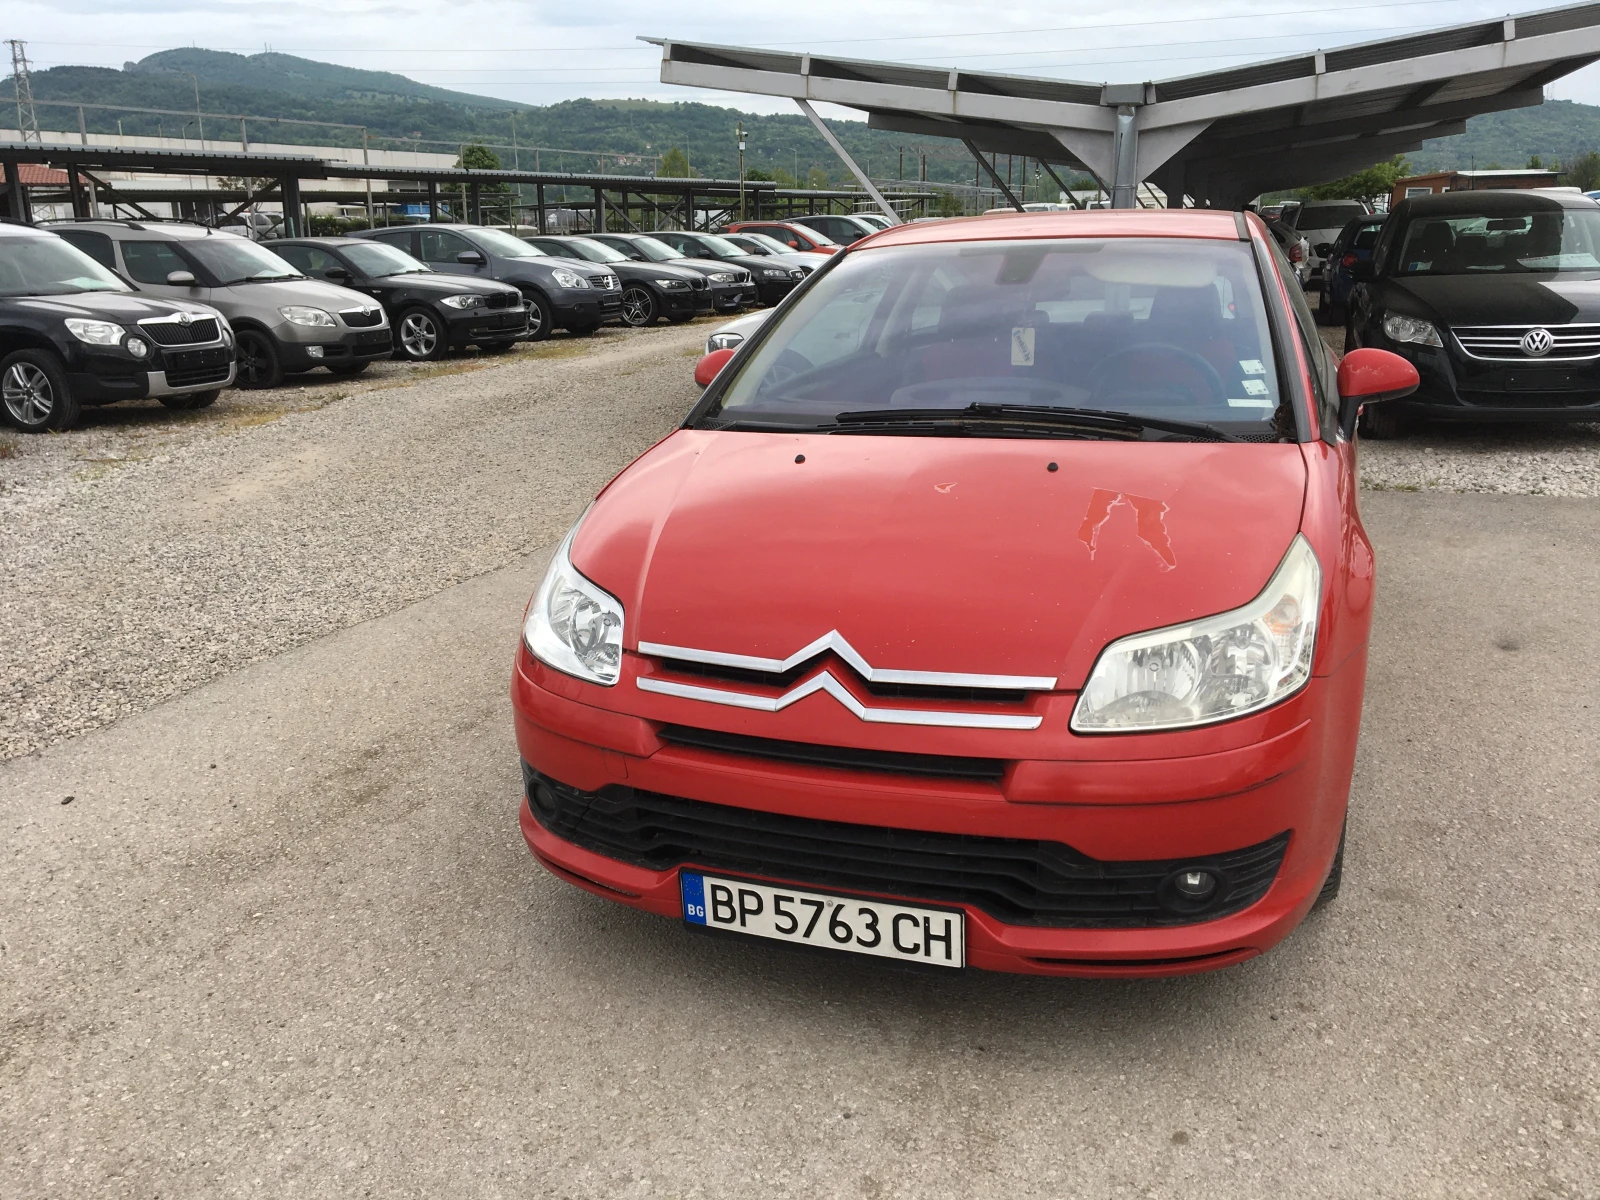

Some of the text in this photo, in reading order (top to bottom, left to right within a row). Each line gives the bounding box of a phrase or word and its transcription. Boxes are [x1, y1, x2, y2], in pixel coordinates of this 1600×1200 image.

[687, 904, 704, 917] BG
[711, 884, 952, 960] BP 5763 CH
